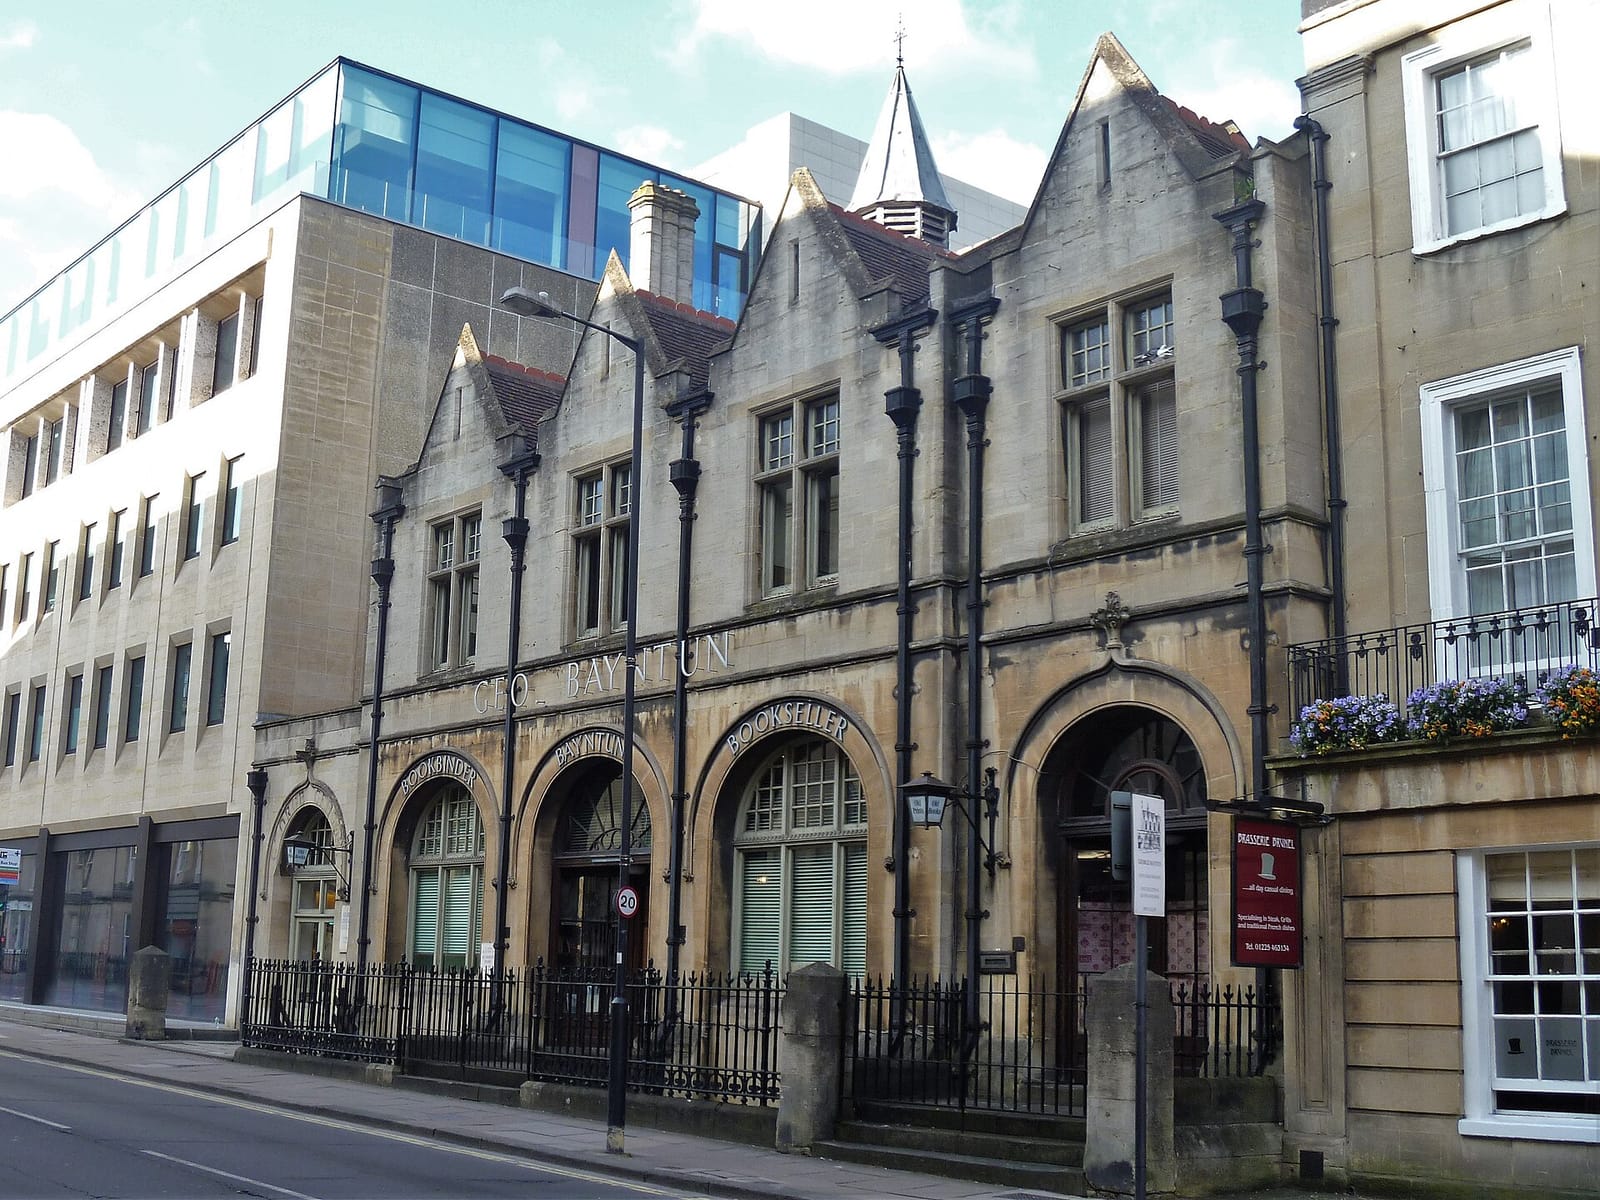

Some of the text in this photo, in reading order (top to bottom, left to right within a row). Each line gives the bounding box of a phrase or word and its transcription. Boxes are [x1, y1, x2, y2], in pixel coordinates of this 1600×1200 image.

[568, 631, 729, 698] BAYNTUN
[727, 702, 848, 755] BOOKSELLER
[555, 732, 625, 766] BAYNTUN
[401, 755, 477, 795] BOOKBINDER
[1237, 832, 1296, 850] BRASSERIE BRUNEL
[620, 894, 636, 909] 20
[1256, 884, 1264, 893] day
[1279, 886, 1294, 896] dining
